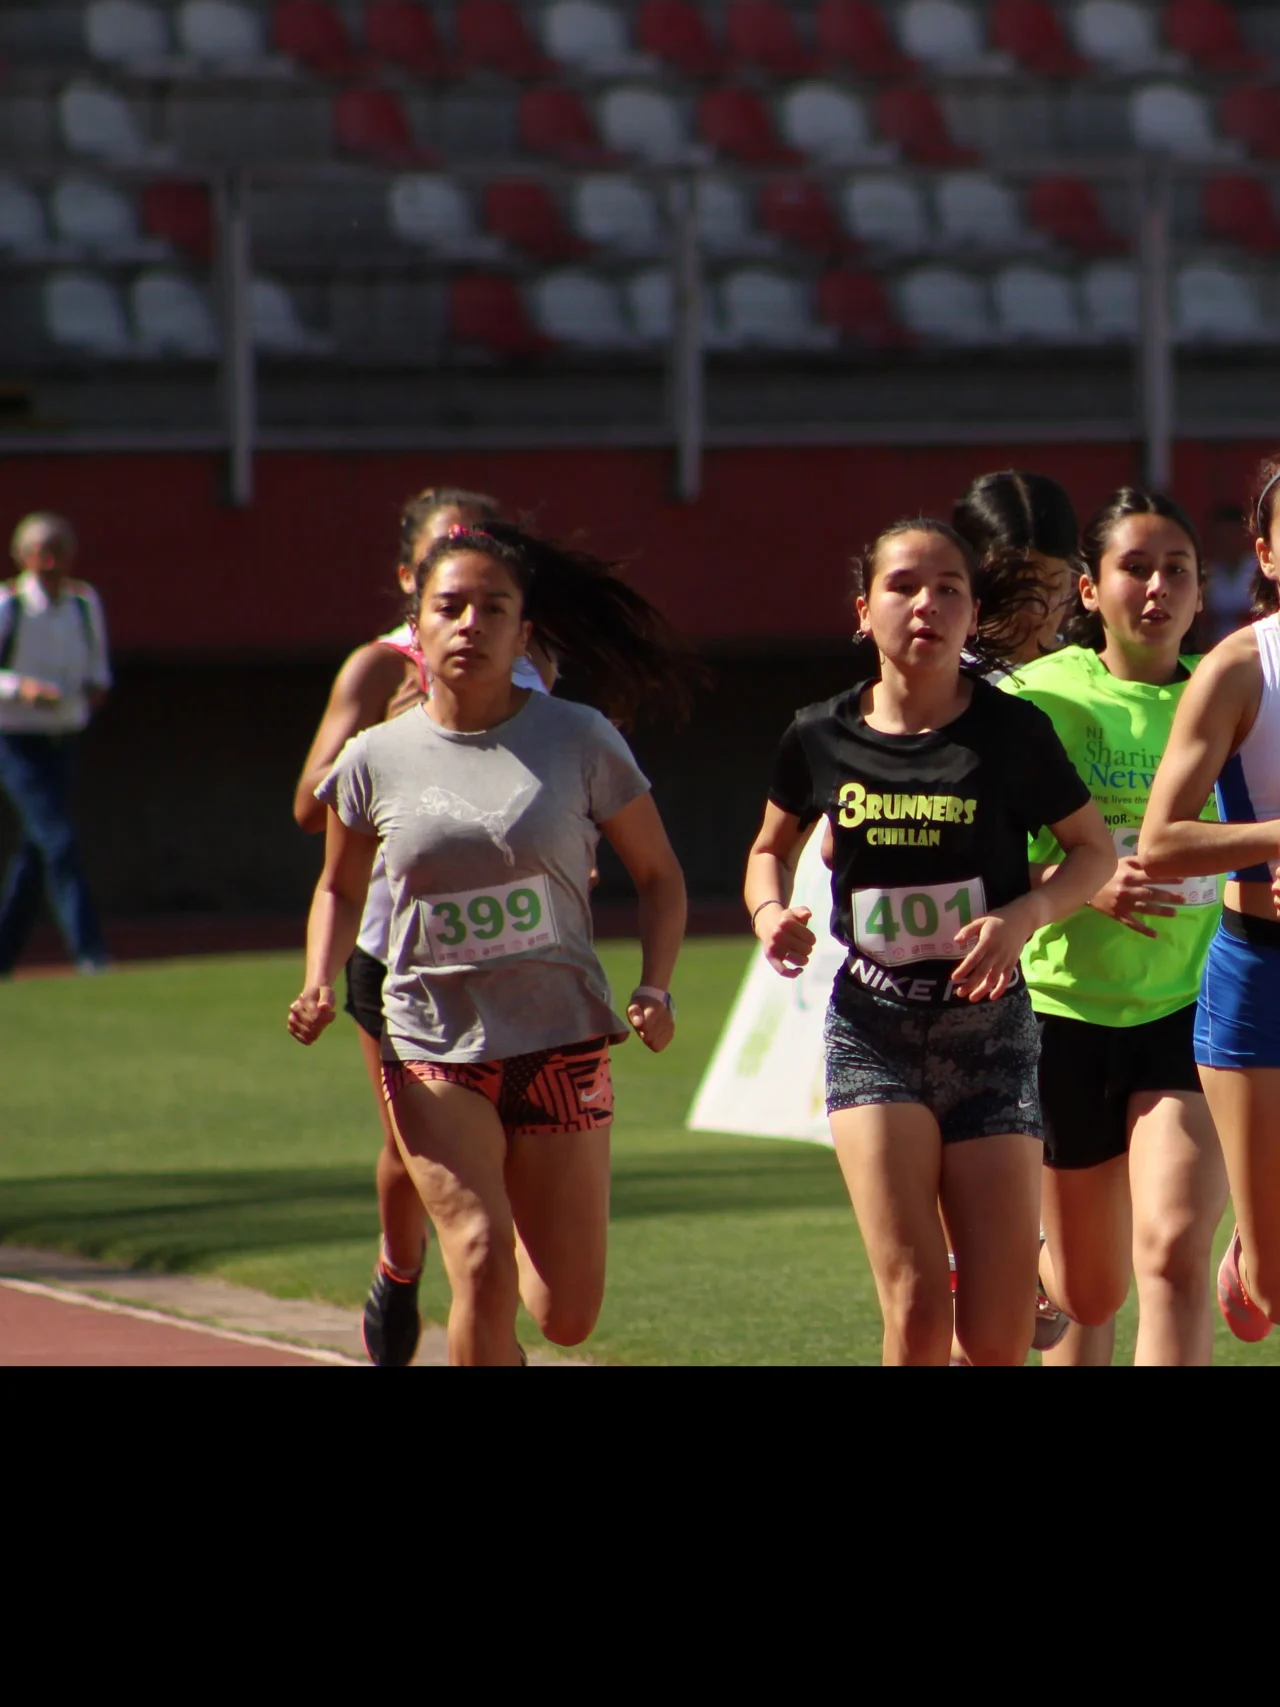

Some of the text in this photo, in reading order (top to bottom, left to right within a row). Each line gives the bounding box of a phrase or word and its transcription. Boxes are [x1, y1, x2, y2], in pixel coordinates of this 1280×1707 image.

[838, 782, 977, 829] 3RUNNERS
[866, 821, 941, 847] CHILLÁN
[431, 887, 542, 946] 399
[865, 887, 975, 942] 401
[850, 958, 937, 1002] NIKE
